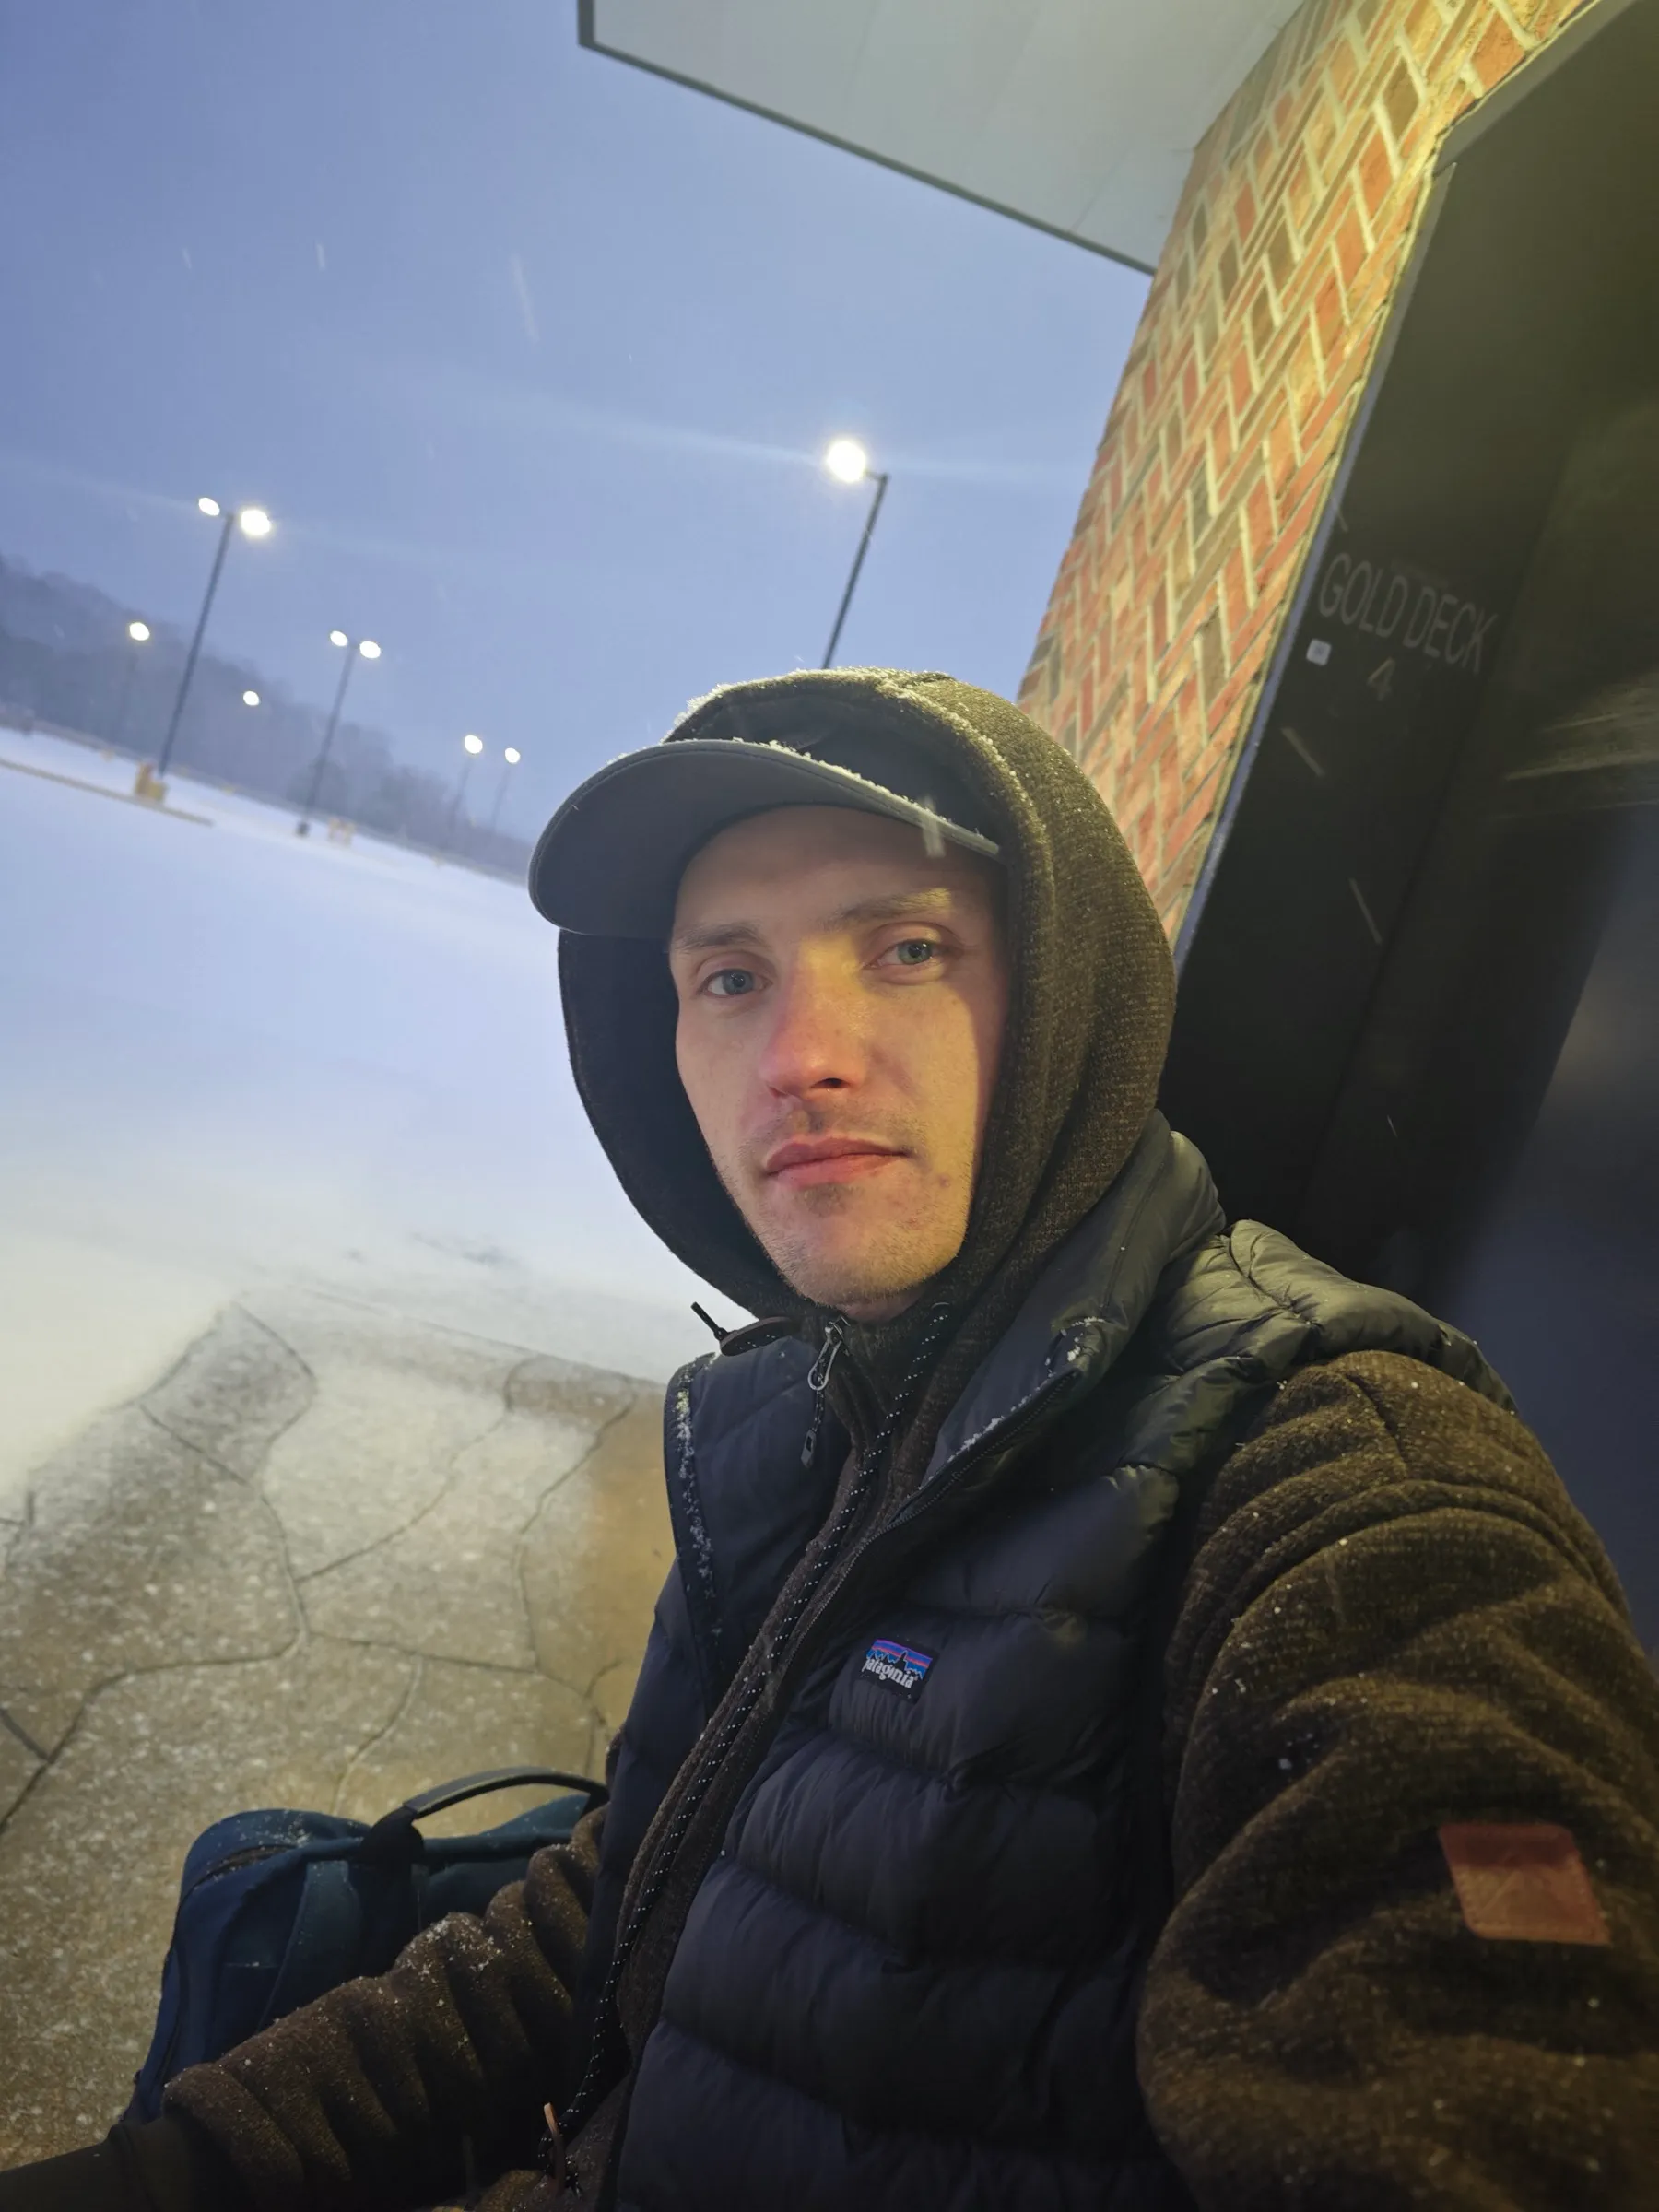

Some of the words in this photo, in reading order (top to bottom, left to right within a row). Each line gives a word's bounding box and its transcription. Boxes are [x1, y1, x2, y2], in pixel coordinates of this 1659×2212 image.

[1319, 553, 1407, 638] GOLD
[1403, 586, 1498, 675] DECK
[1368, 656, 1395, 700] 4
